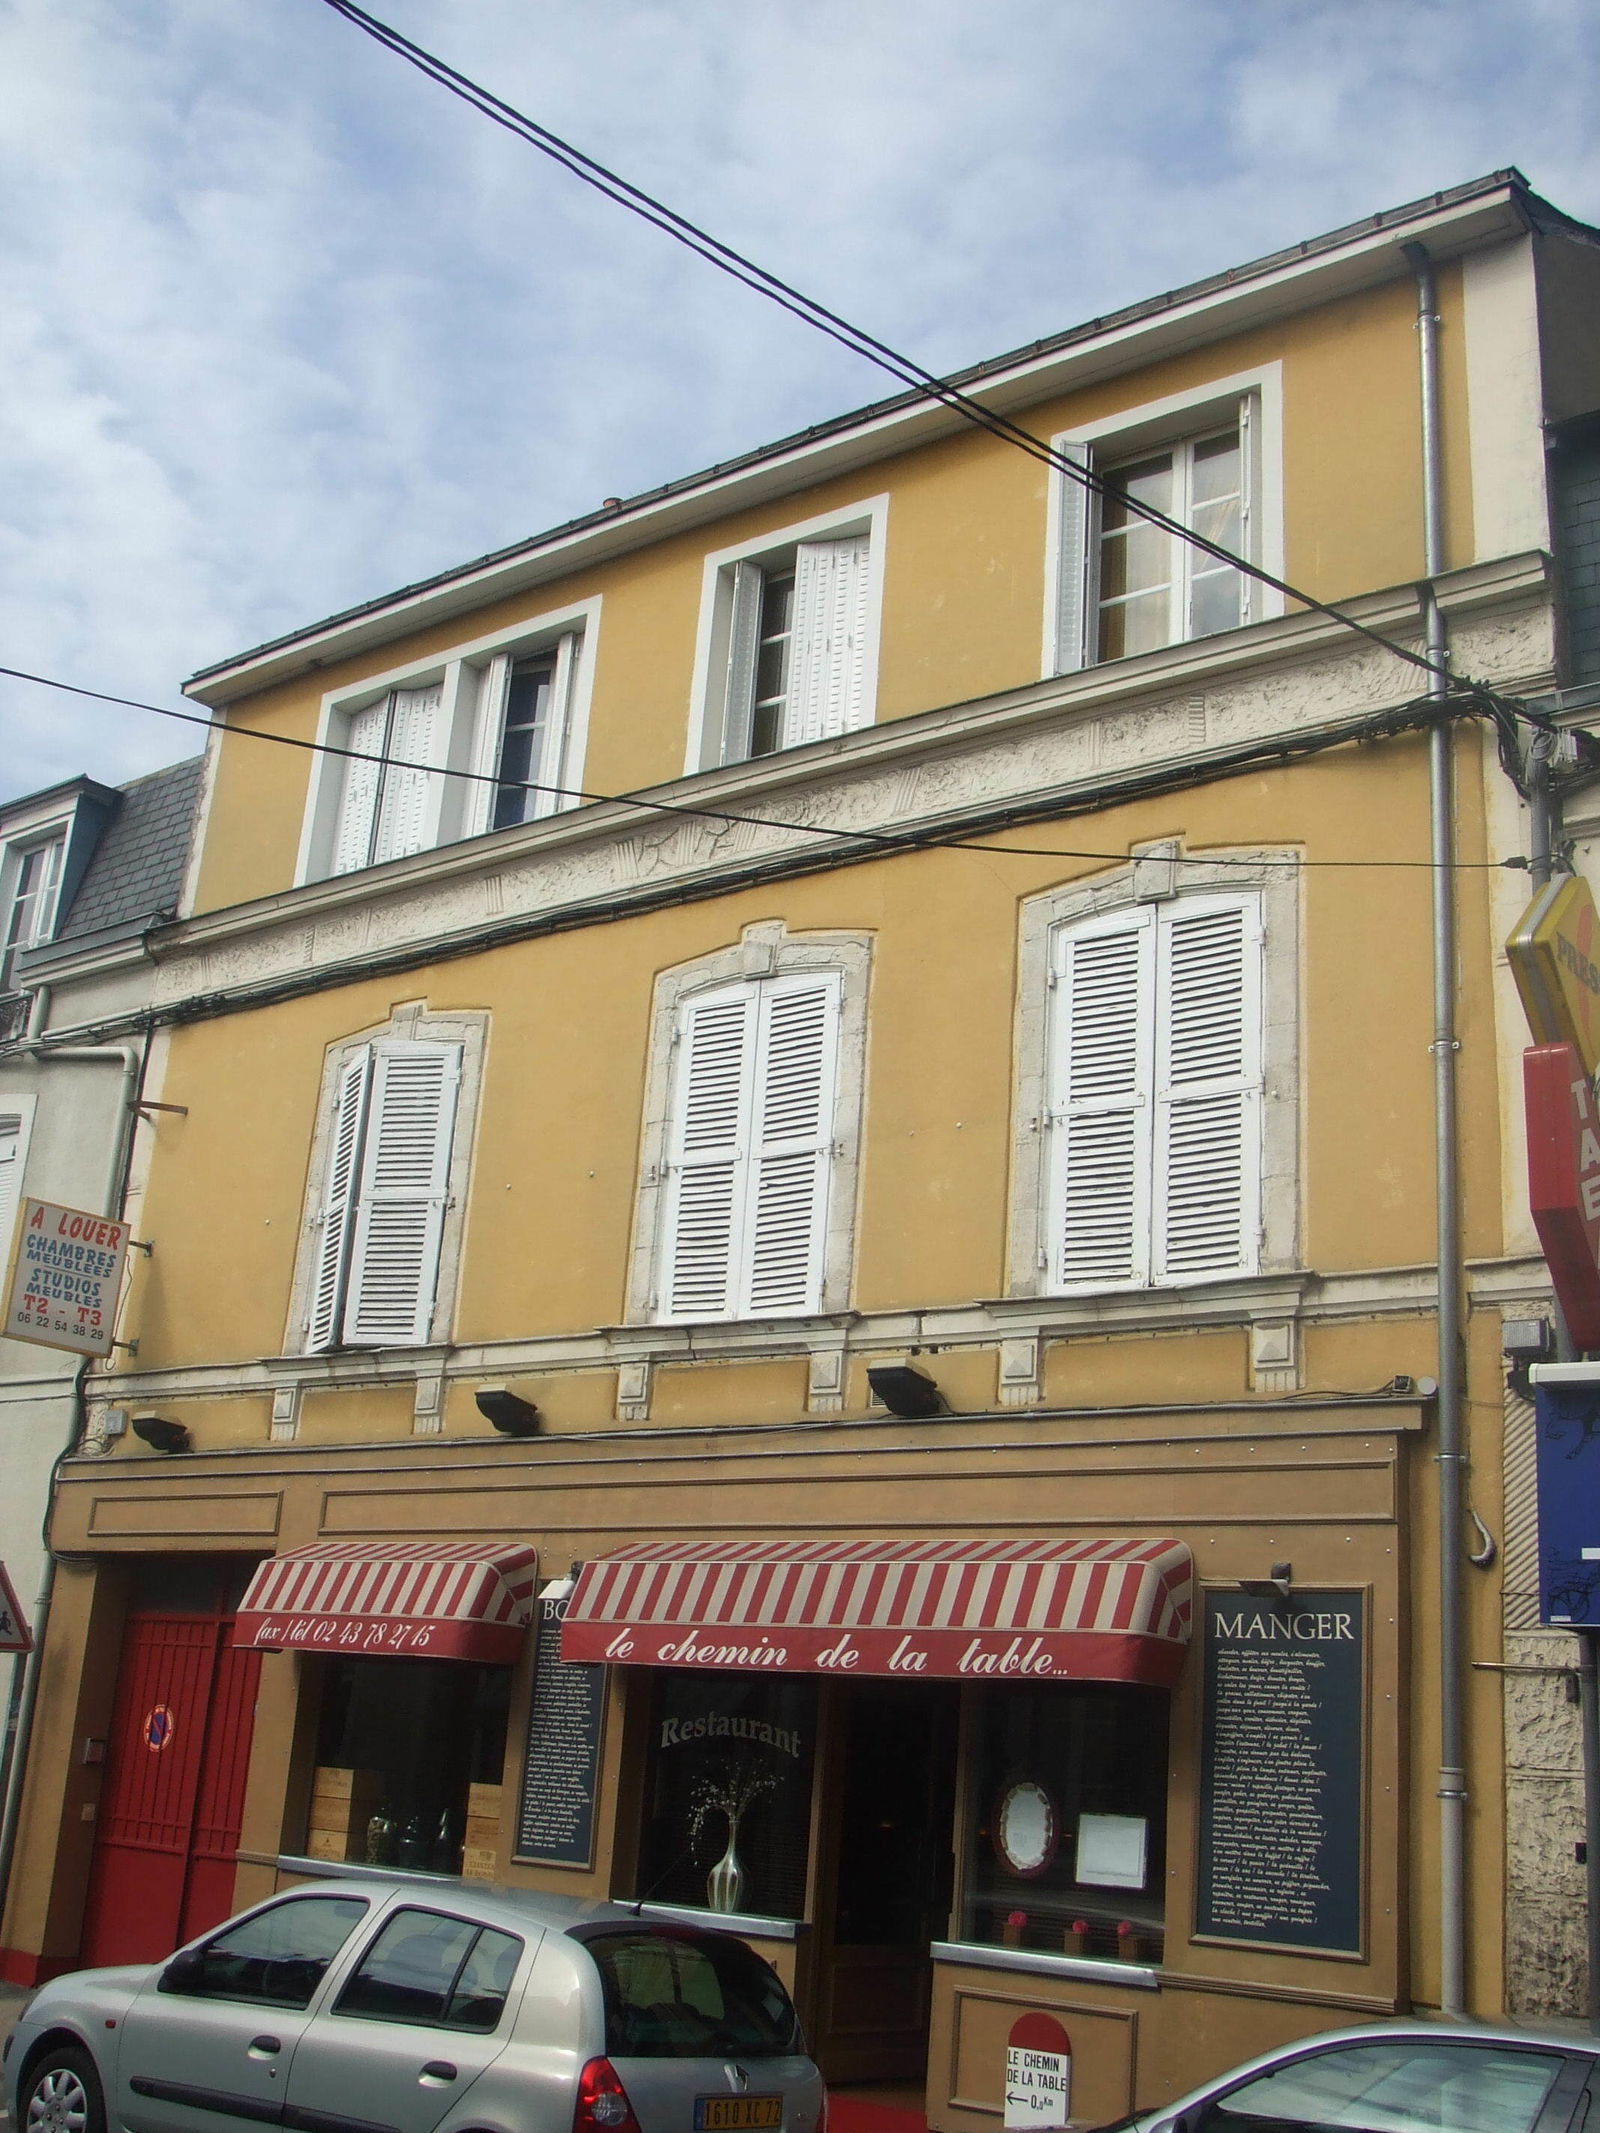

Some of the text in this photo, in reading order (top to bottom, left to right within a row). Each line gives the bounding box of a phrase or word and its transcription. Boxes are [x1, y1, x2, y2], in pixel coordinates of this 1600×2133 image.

[30, 1206, 122, 1250] A LOUER
[26, 1249, 112, 1278] MEUBLEES
[27, 1234, 117, 1268] CHAMBRES
[26, 1282, 103, 1308] MEUBLES
[31, 1268, 101, 1296] STUDIOS
[23, 1293, 49, 1314] T2
[77, 1306, 102, 1326] T3
[17, 1311, 104, 1340] 06 22 54 38 29
[253, 1617, 281, 1646] fax
[313, 1620, 337, 1643] 02
[339, 1621, 363, 1645] 43
[363, 1623, 388, 1649] 78
[388, 1623, 413, 1650] 27
[410, 1625, 436, 1647] 15
[1214, 1612, 1355, 1640] MANGER
[604, 1628, 635, 1659] le
[657, 1629, 788, 1666] chemin
[814, 1633, 859, 1669] de
[886, 1635, 929, 1672] la
[660, 1711, 803, 1759] Restaurant
[1008, 2050, 1060, 2072] LE CHEMIN
[1007, 2068, 1067, 2091] DE LA TABLE
[706, 2102, 740, 2126] 1610
[766, 2100, 780, 2123] 72
